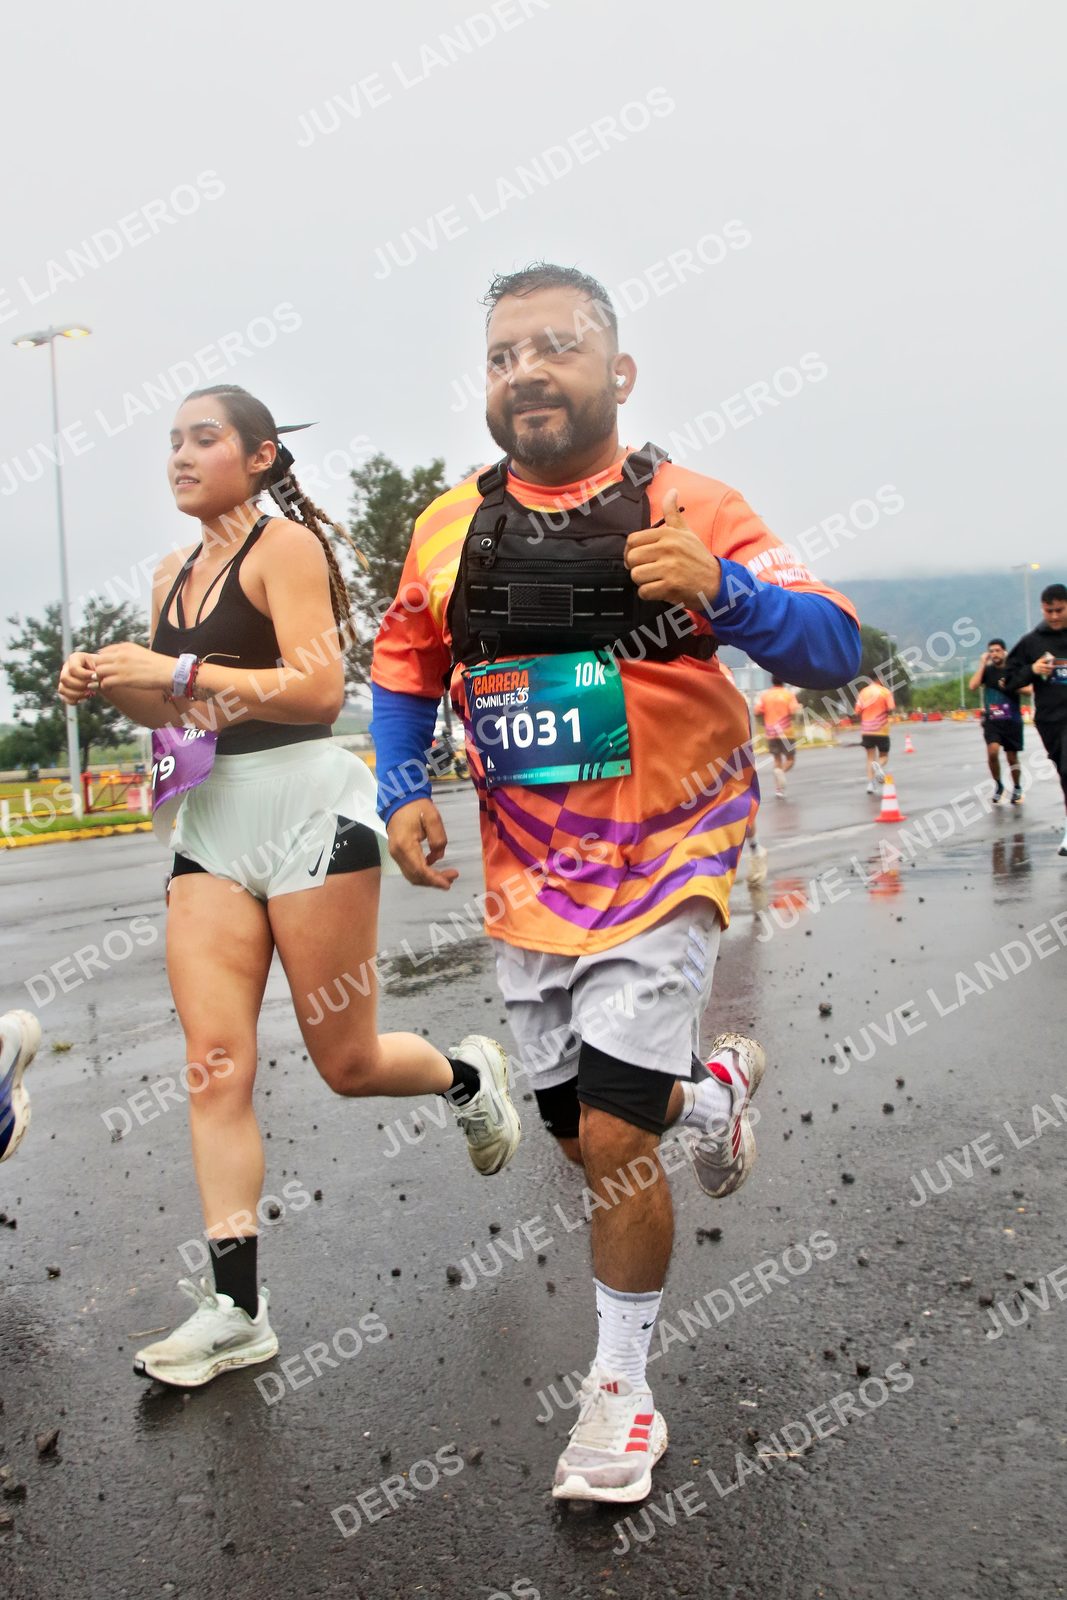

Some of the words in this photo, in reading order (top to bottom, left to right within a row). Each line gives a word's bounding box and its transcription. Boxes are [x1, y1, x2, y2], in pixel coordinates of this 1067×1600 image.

[474, 670, 529, 696] CARRERA
[575, 661, 607, 688] 10K
[476, 692, 516, 710] OMNILIFE
[494, 708, 582, 750] 1031
